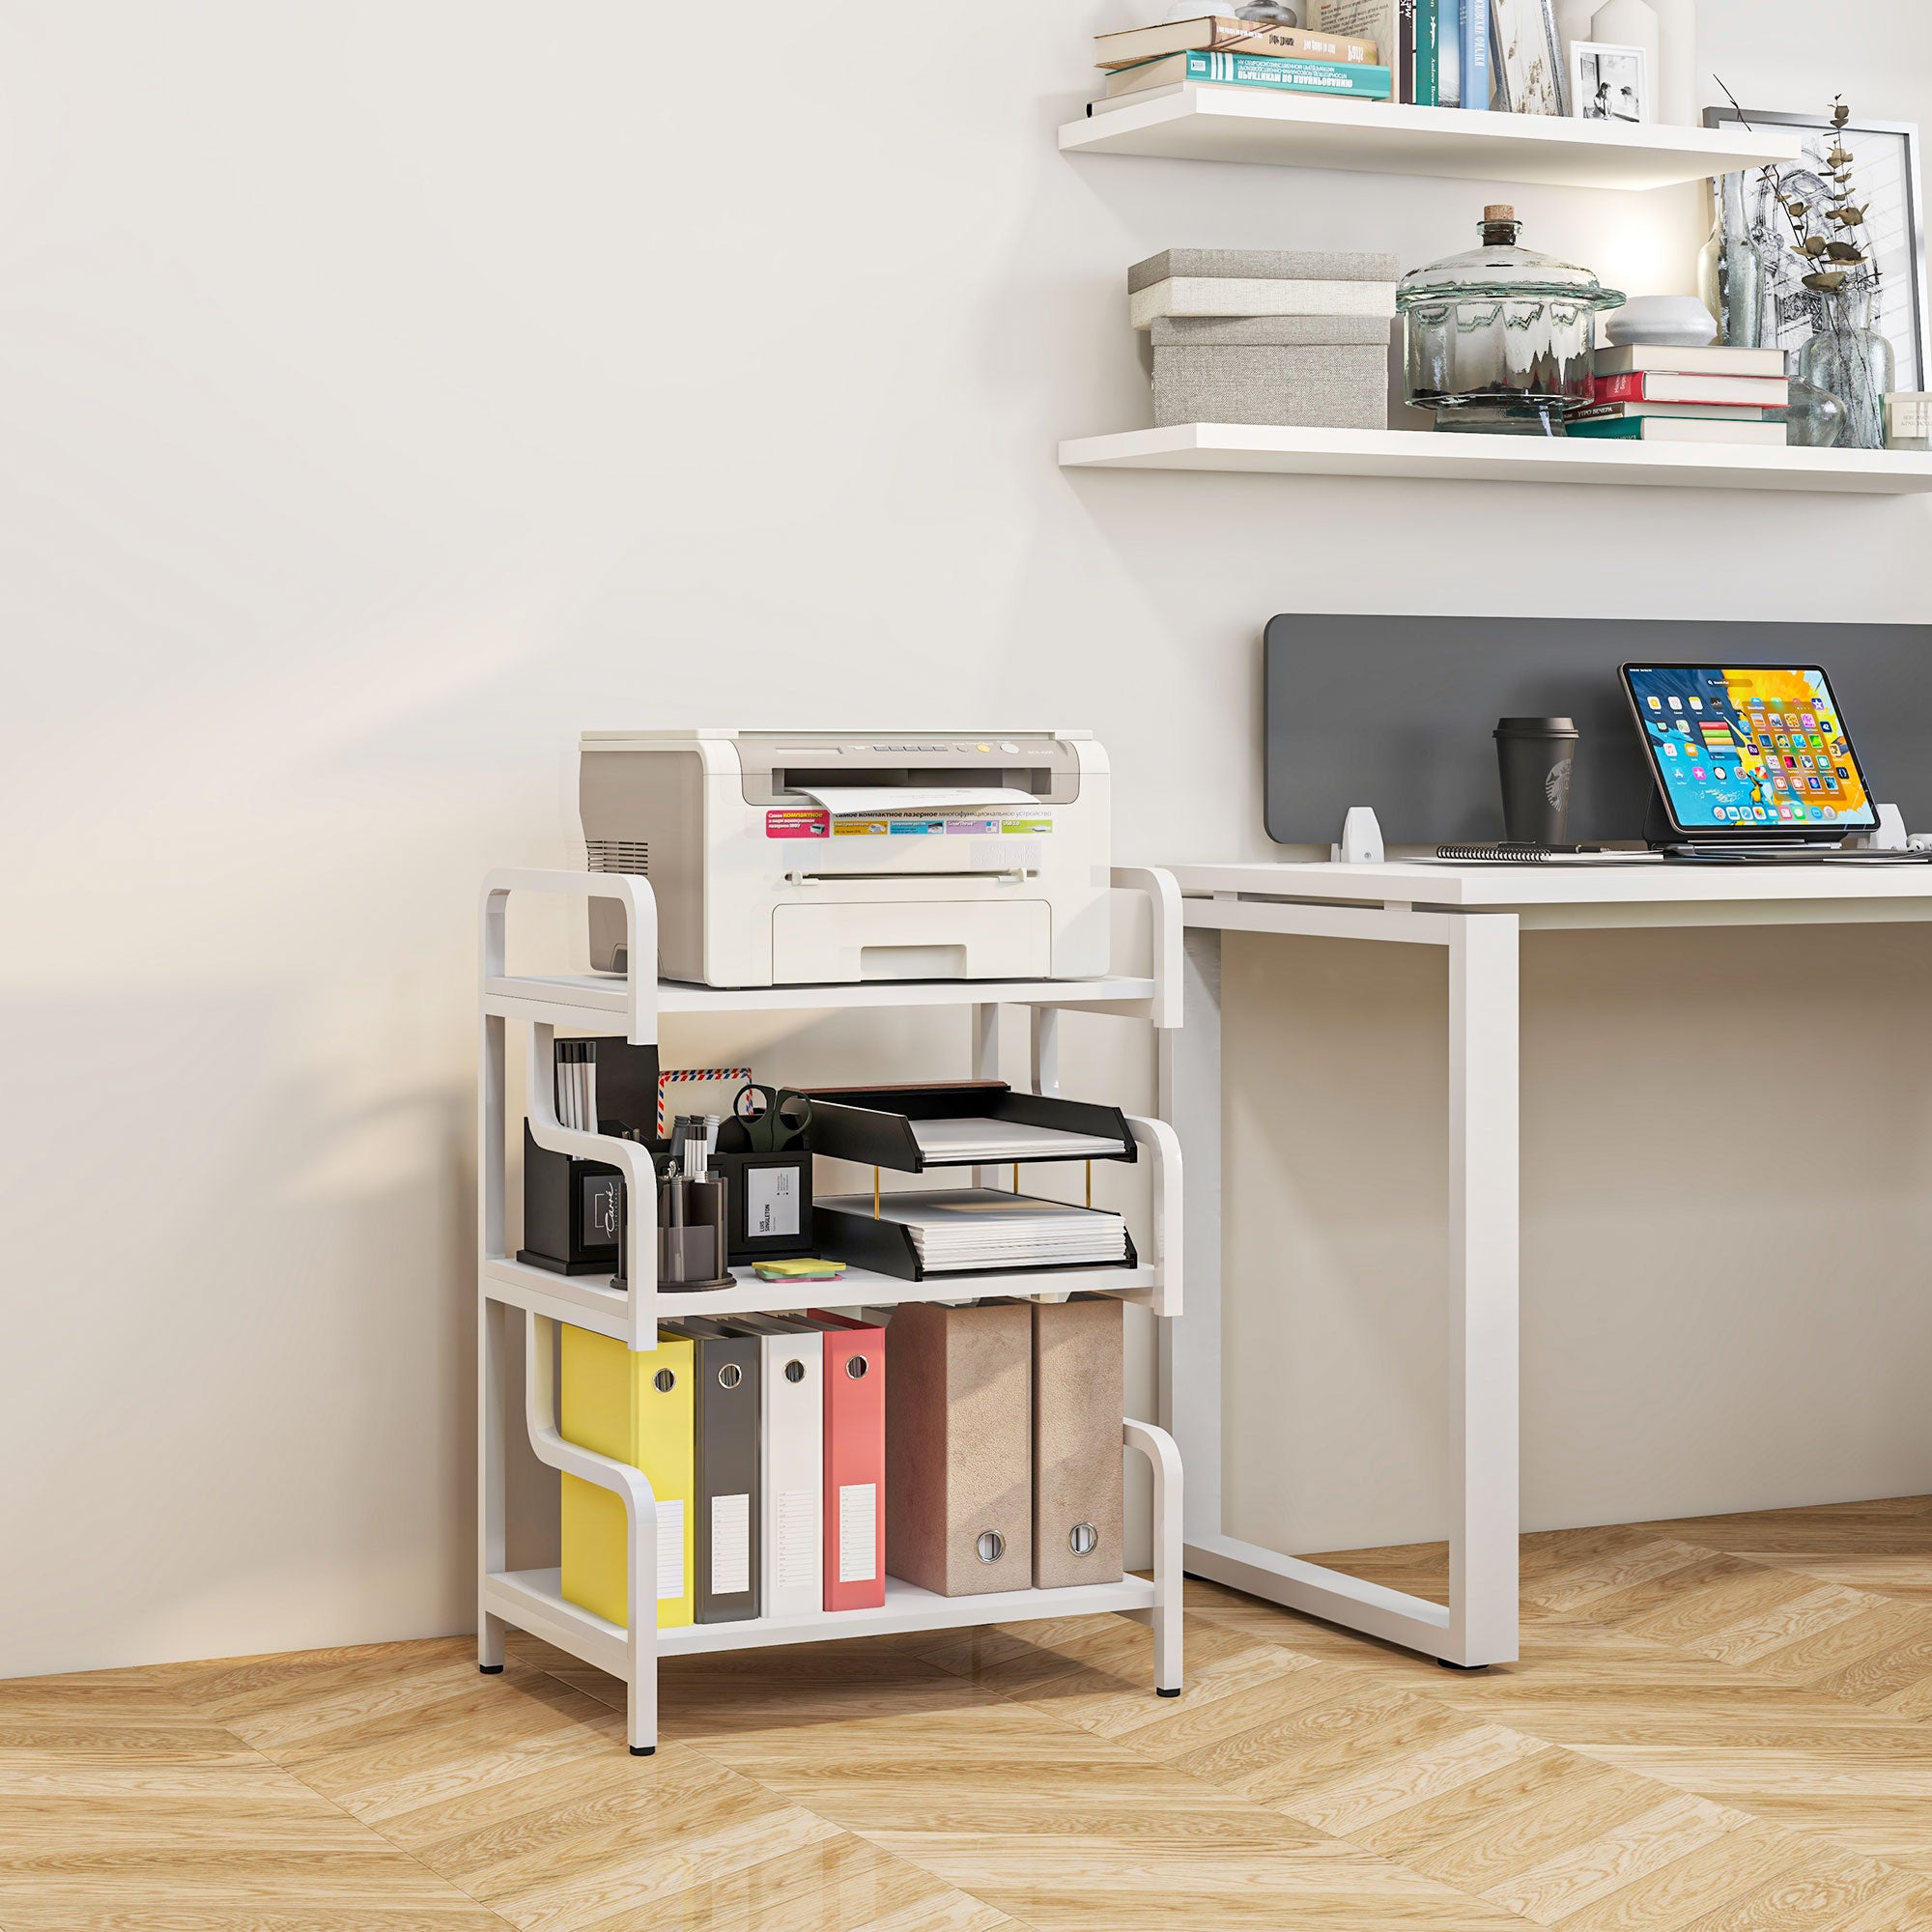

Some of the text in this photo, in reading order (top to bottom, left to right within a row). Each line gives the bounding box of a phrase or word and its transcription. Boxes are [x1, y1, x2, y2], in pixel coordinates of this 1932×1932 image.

[1474, 37, 1486, 67] ФИАЛКИ
[938, 810, 1015, 819] многофункциональное
[1015, 810, 1052, 819] устройство
